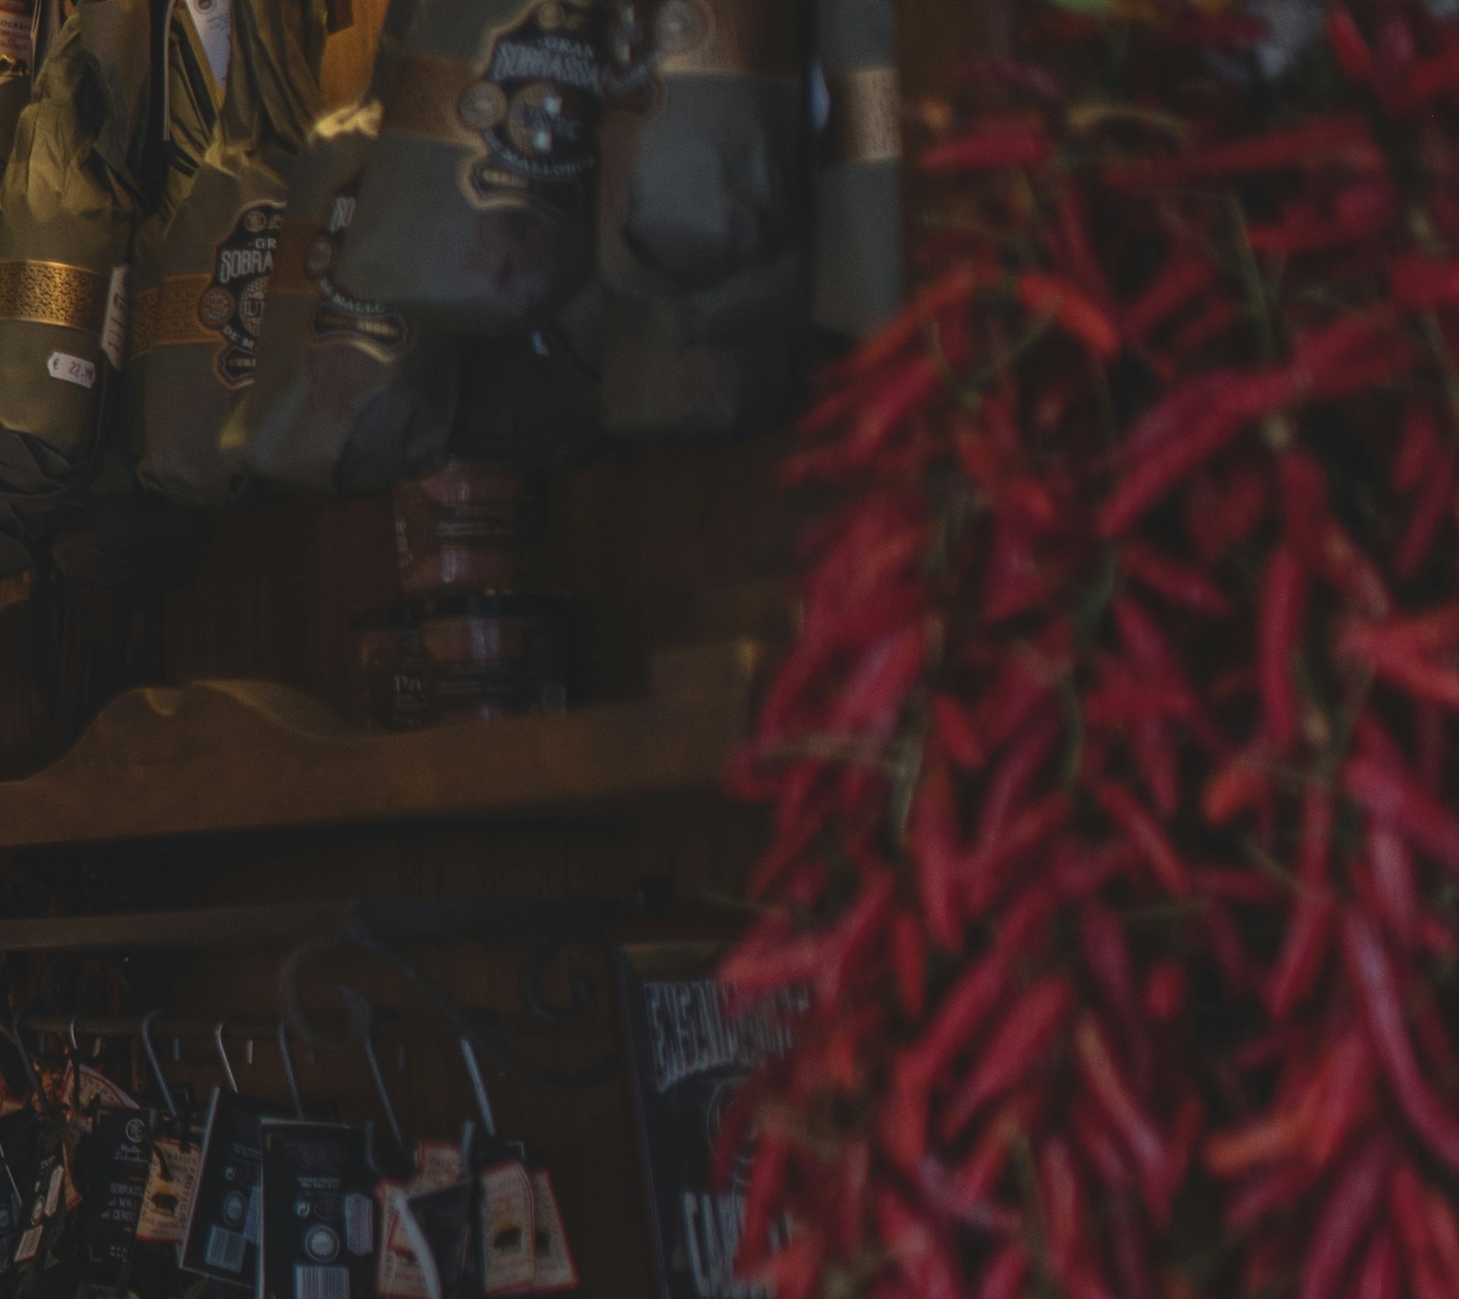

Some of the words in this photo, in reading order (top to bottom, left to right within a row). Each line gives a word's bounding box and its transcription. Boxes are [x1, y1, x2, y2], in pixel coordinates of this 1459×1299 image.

[254, 238, 277, 249] GR
[219, 250, 274, 284] SOBRA
[241, 336, 256, 349] M
